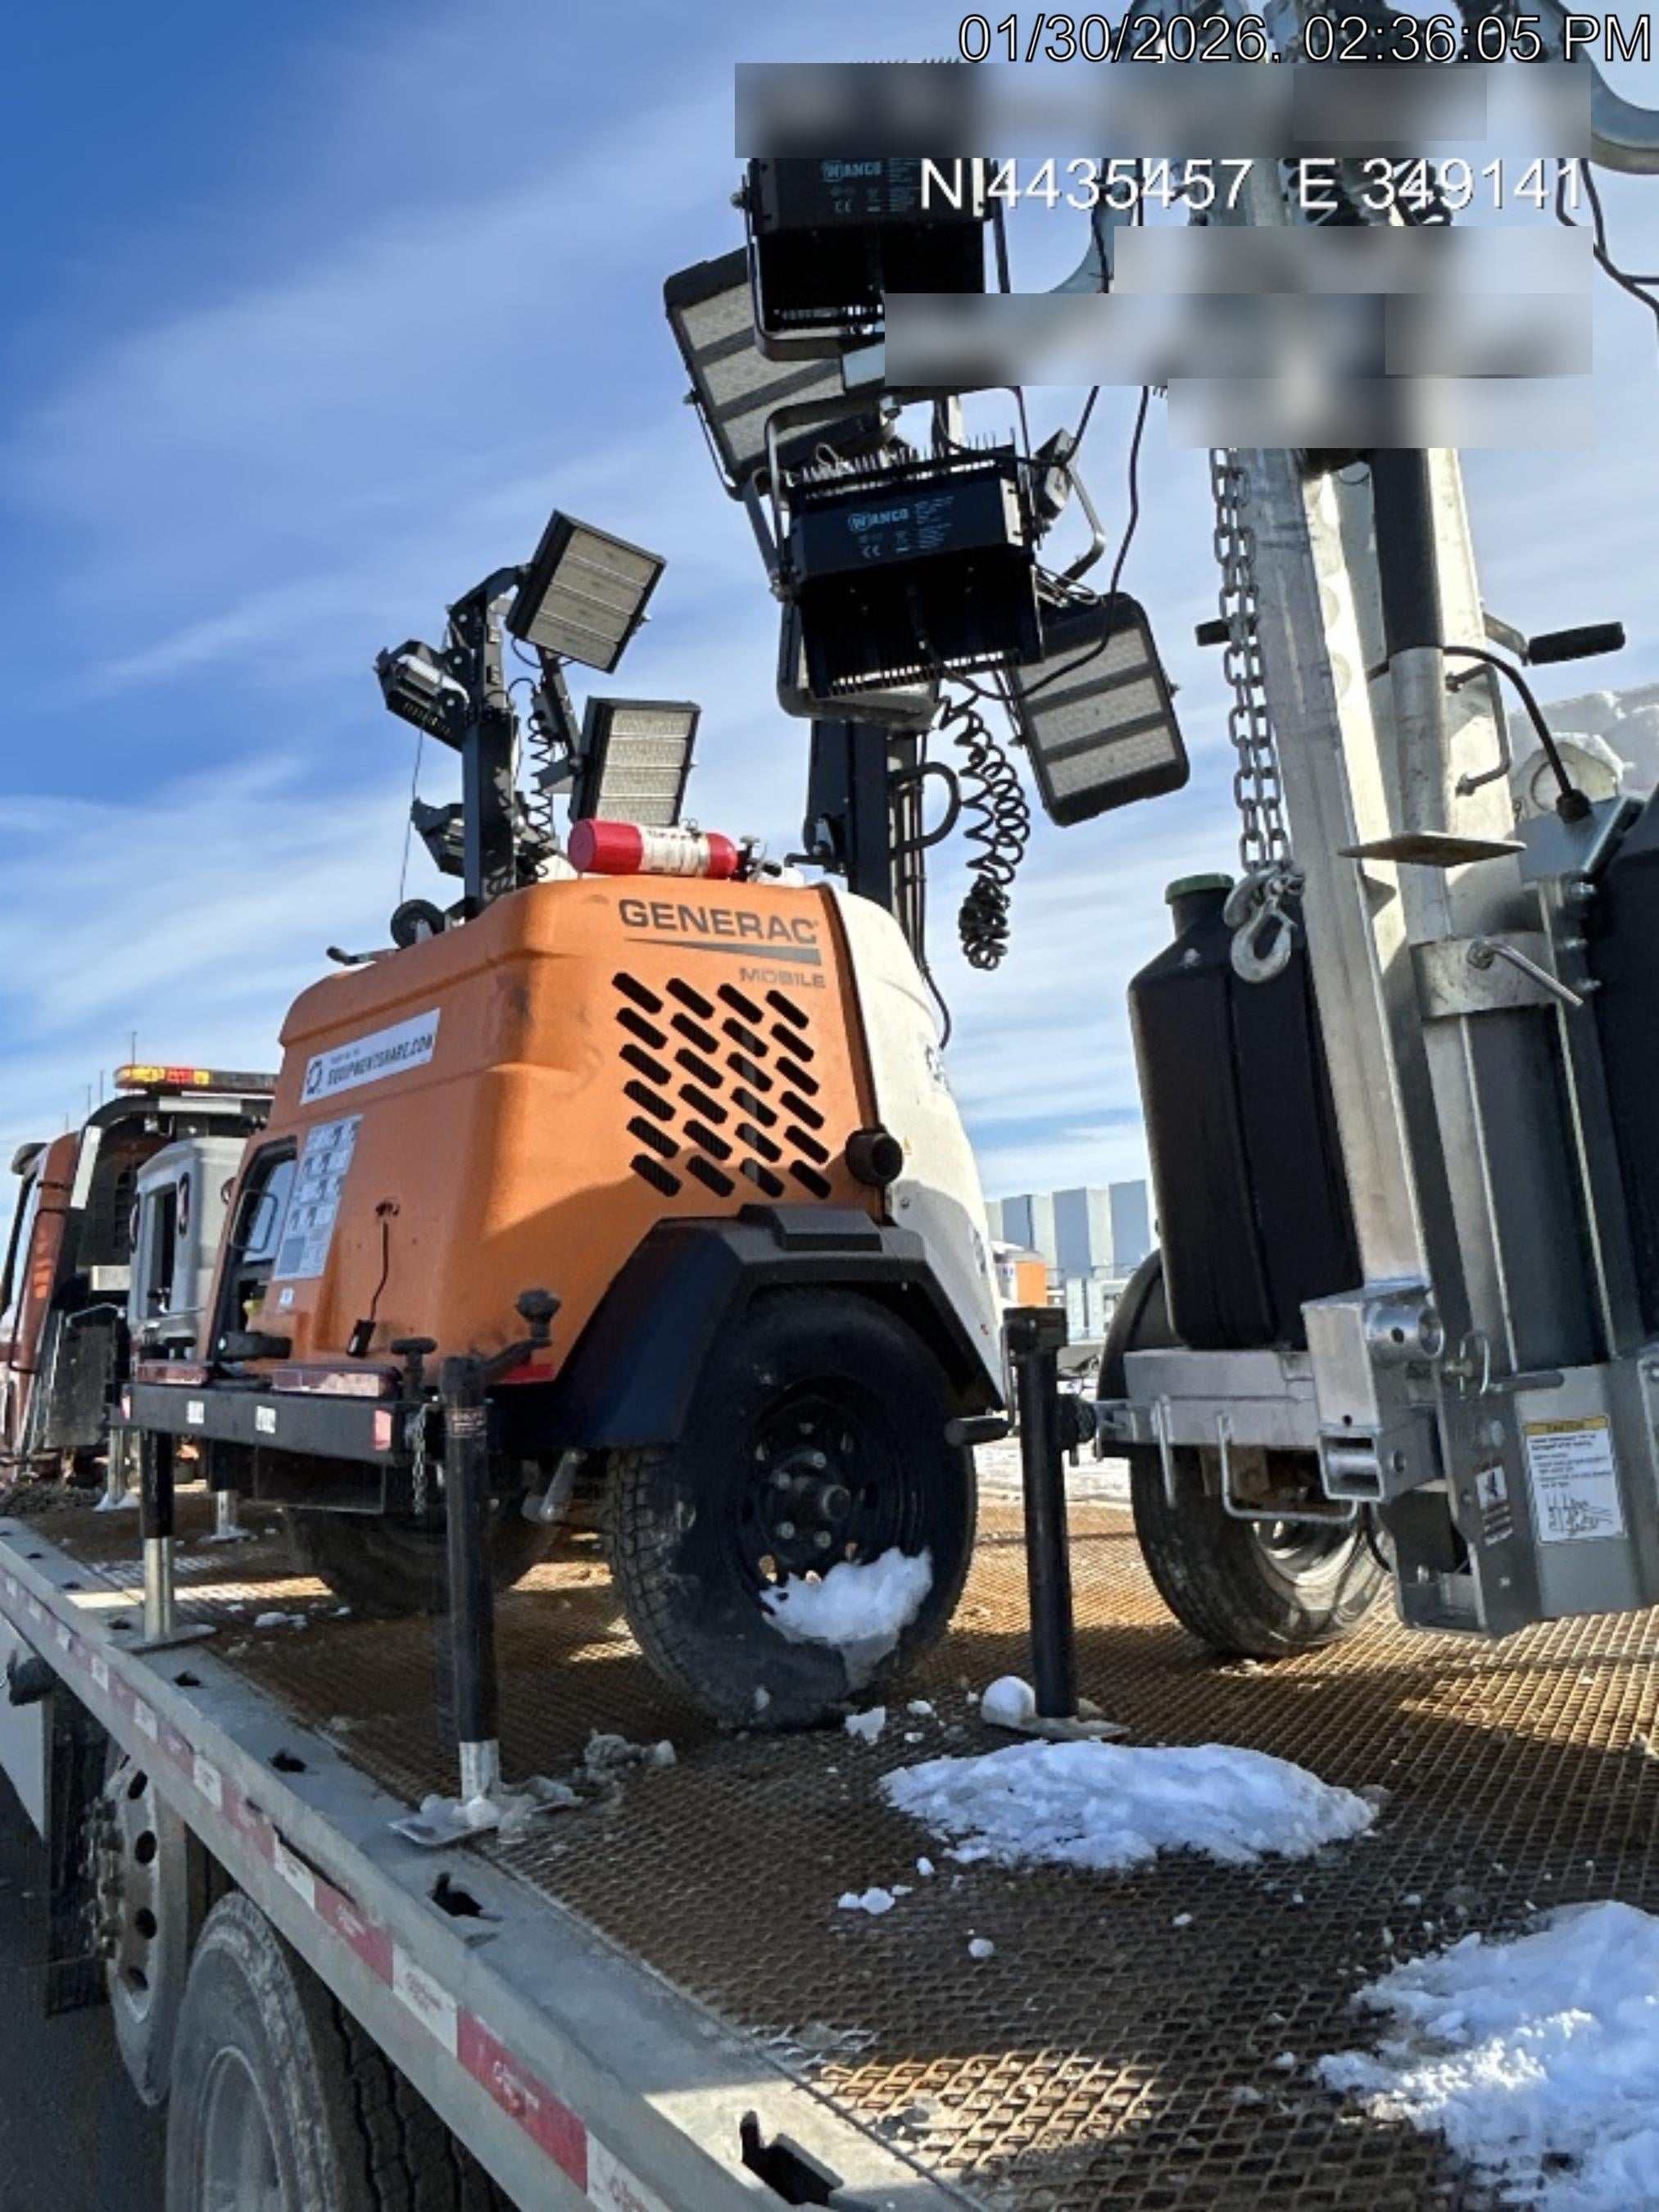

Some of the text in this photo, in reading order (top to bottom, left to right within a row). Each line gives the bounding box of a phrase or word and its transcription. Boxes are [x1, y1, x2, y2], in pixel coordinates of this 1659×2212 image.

[848, 508, 909, 532] WANCO
[619, 899, 817, 944] GENERAC
[739, 967, 826, 989] MOBILE
